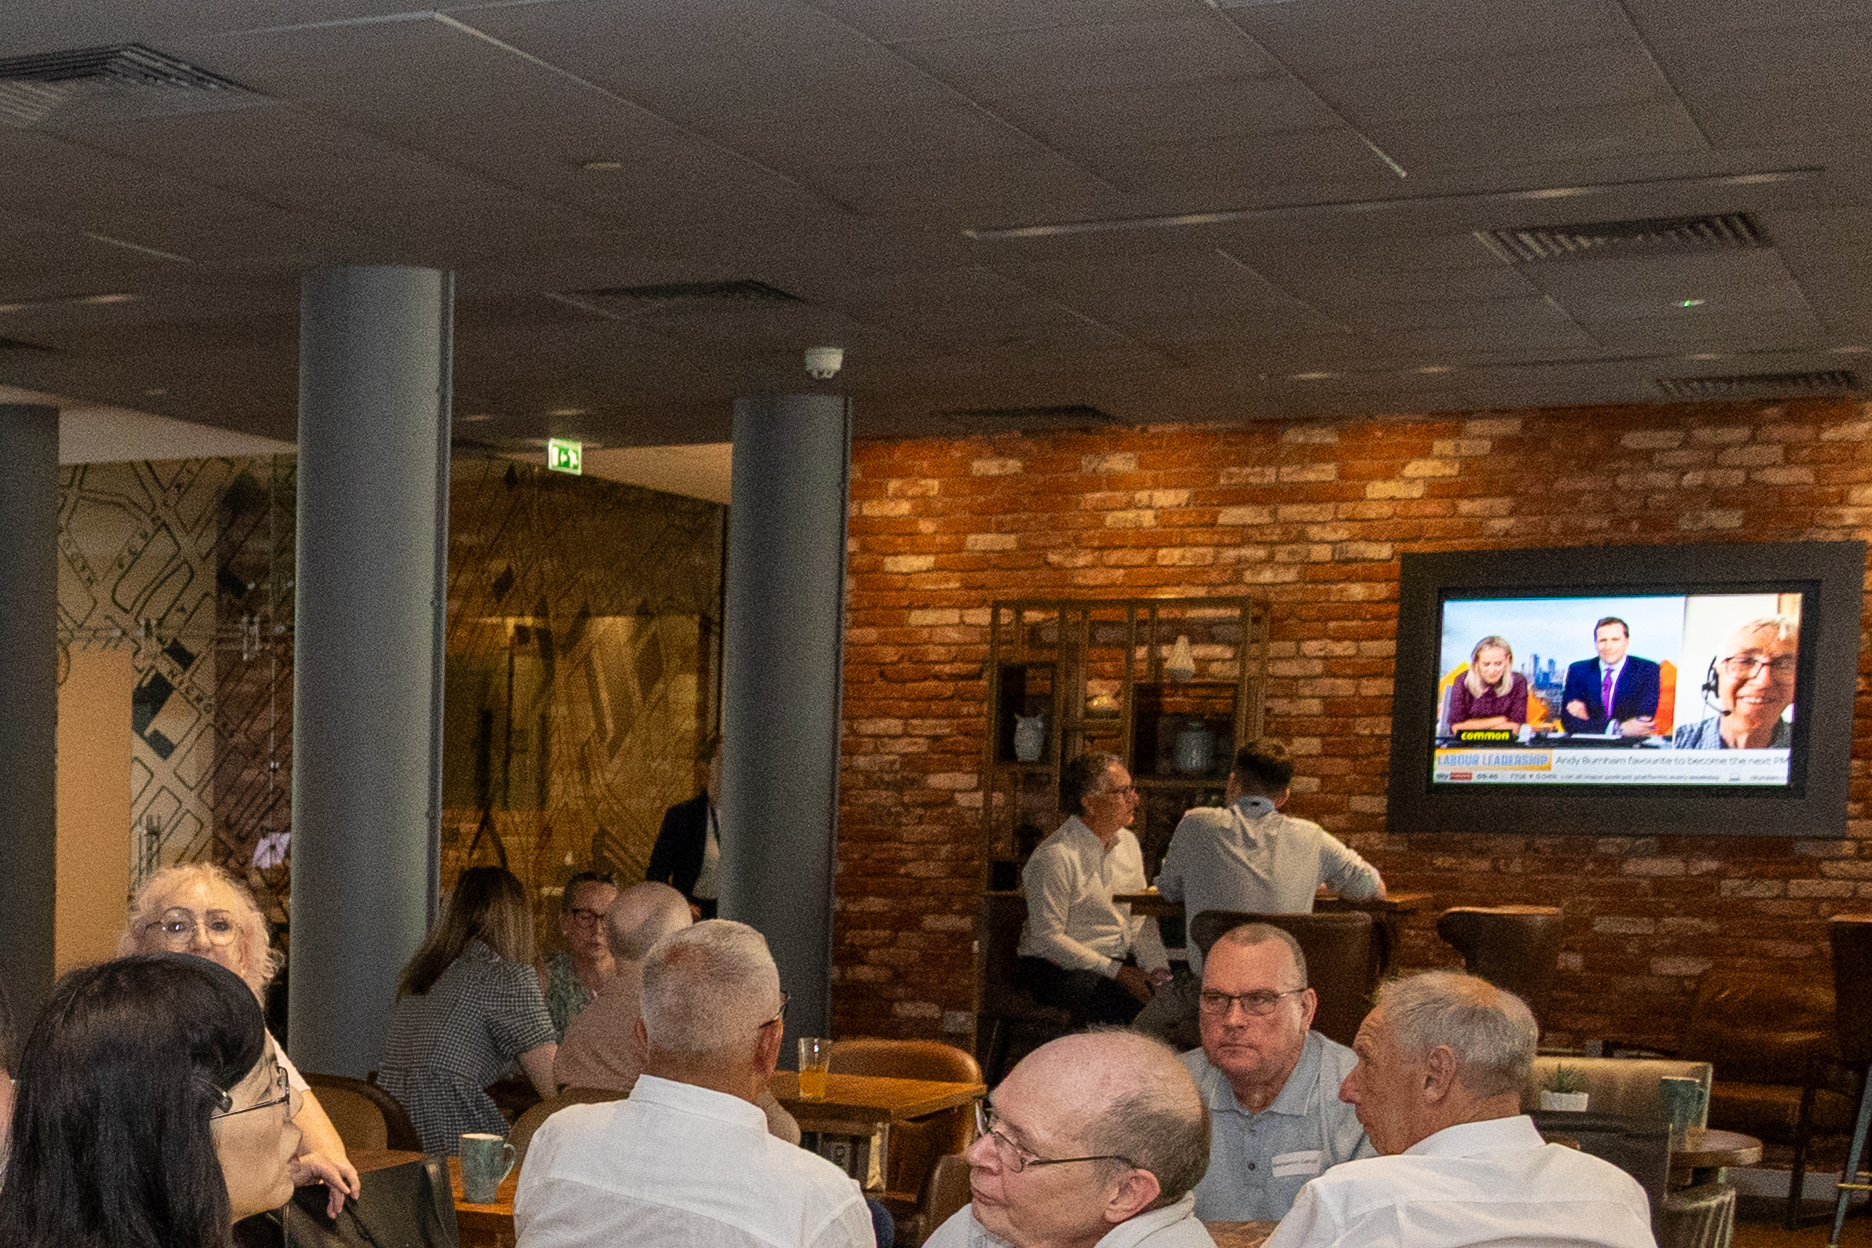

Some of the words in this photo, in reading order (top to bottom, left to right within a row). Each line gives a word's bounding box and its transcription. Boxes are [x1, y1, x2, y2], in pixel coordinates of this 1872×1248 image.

[1461, 731, 1509, 741] common
[1437, 754, 1479, 766] LABOUR
[1482, 753, 1549, 766] LEADERSHIP
[1555, 756, 1580, 767] Andy
[1582, 756, 1627, 766] Burnham
[1628, 756, 1673, 766] favourite
[1674, 756, 1686, 766] to
[1687, 756, 1727, 766] become
[1729, 756, 1747, 766] the
[1749, 756, 1770, 766] next
